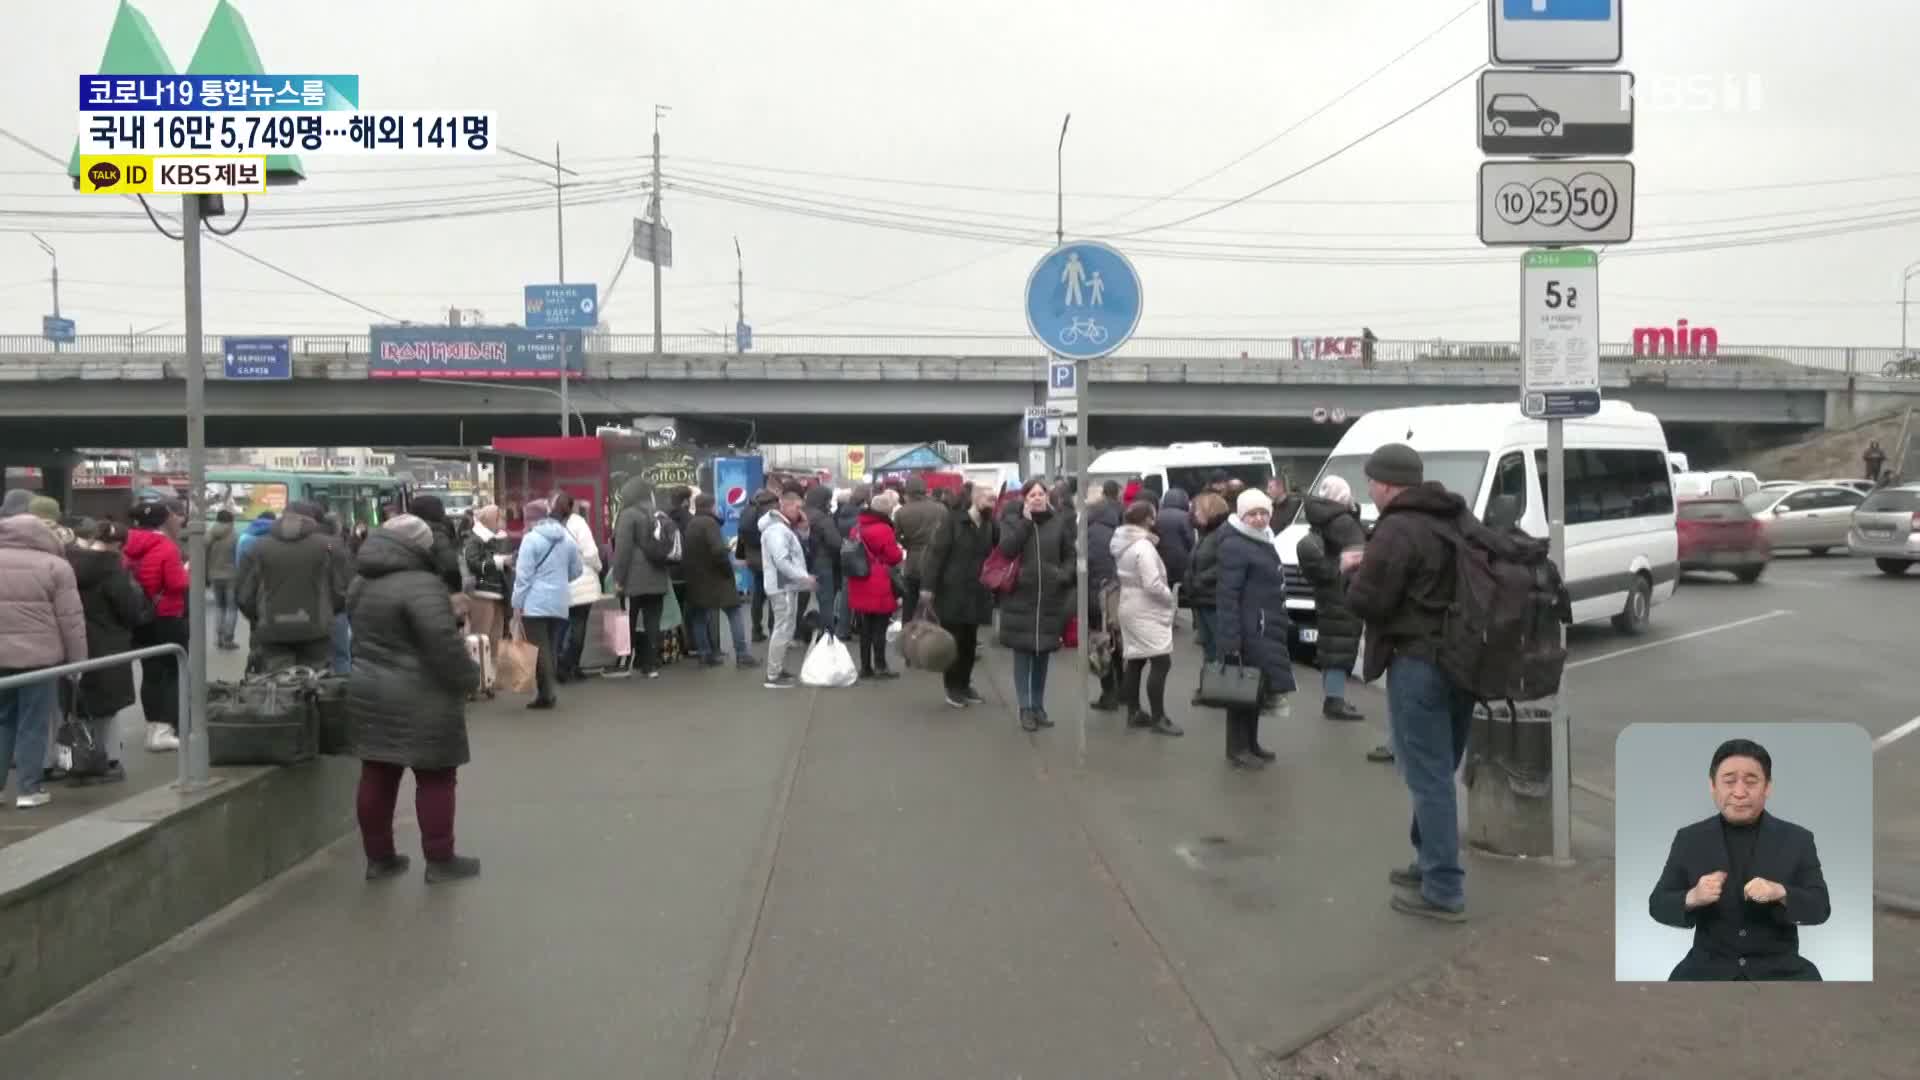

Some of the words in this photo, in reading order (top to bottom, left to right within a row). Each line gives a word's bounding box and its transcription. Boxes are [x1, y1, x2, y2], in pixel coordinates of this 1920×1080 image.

[1503, 193, 1523, 213] 10
[1535, 191, 1562, 214] 25
[1572, 187, 1608, 217] 50
[1633, 319, 1718, 357] min
[381, 341, 430, 363] IRON
[432, 341, 507, 363] MAIDEN
[1057, 367, 1070, 386] P
[1033, 420, 1044, 437] P
